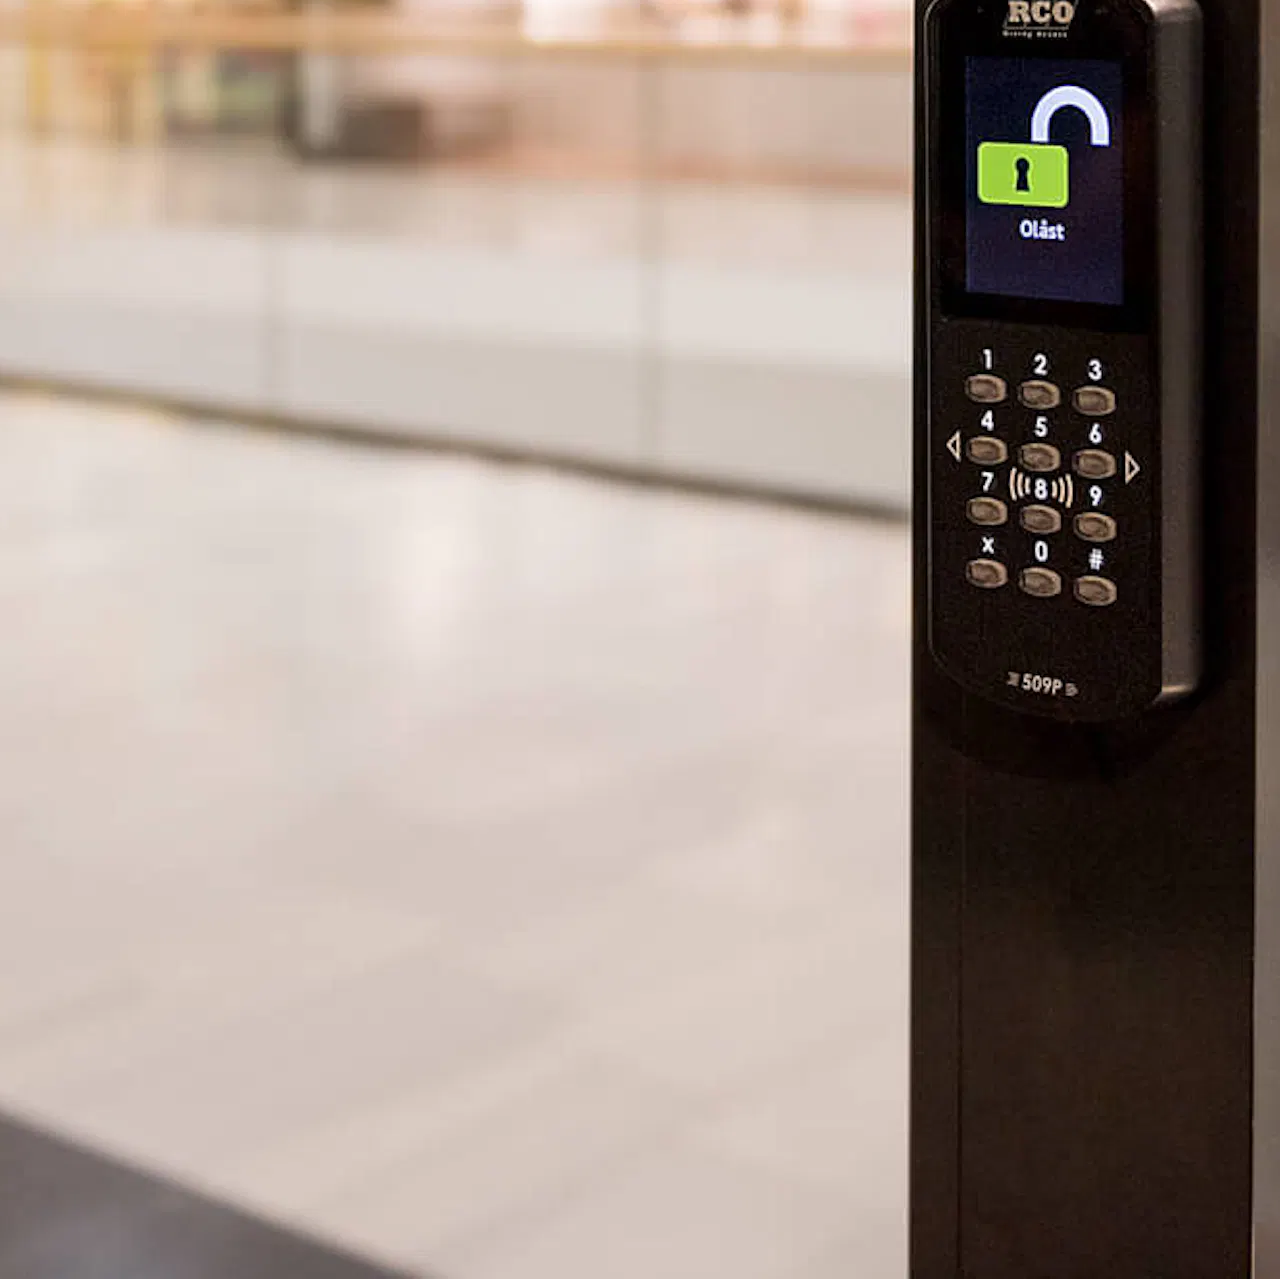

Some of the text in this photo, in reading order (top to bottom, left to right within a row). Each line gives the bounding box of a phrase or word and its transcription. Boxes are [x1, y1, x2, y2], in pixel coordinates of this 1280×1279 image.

[1007, 0, 1075, 24] RCO
[1019, 218, 1066, 241] Olåst
[982, 348, 993, 370] 1
[1033, 353, 1048, 376] 2
[1087, 358, 1103, 381] 3
[980, 409, 995, 432] 4
[1034, 415, 1048, 438] 5
[1088, 422, 1103, 445] 6
[980, 471, 995, 492] 7
[1033, 477, 1049, 501] 8
[1088, 484, 1103, 507] 9
[1033, 540, 1049, 563] 0
[1088, 547, 1104, 571] #
[1021, 672, 1063, 696] 509P
